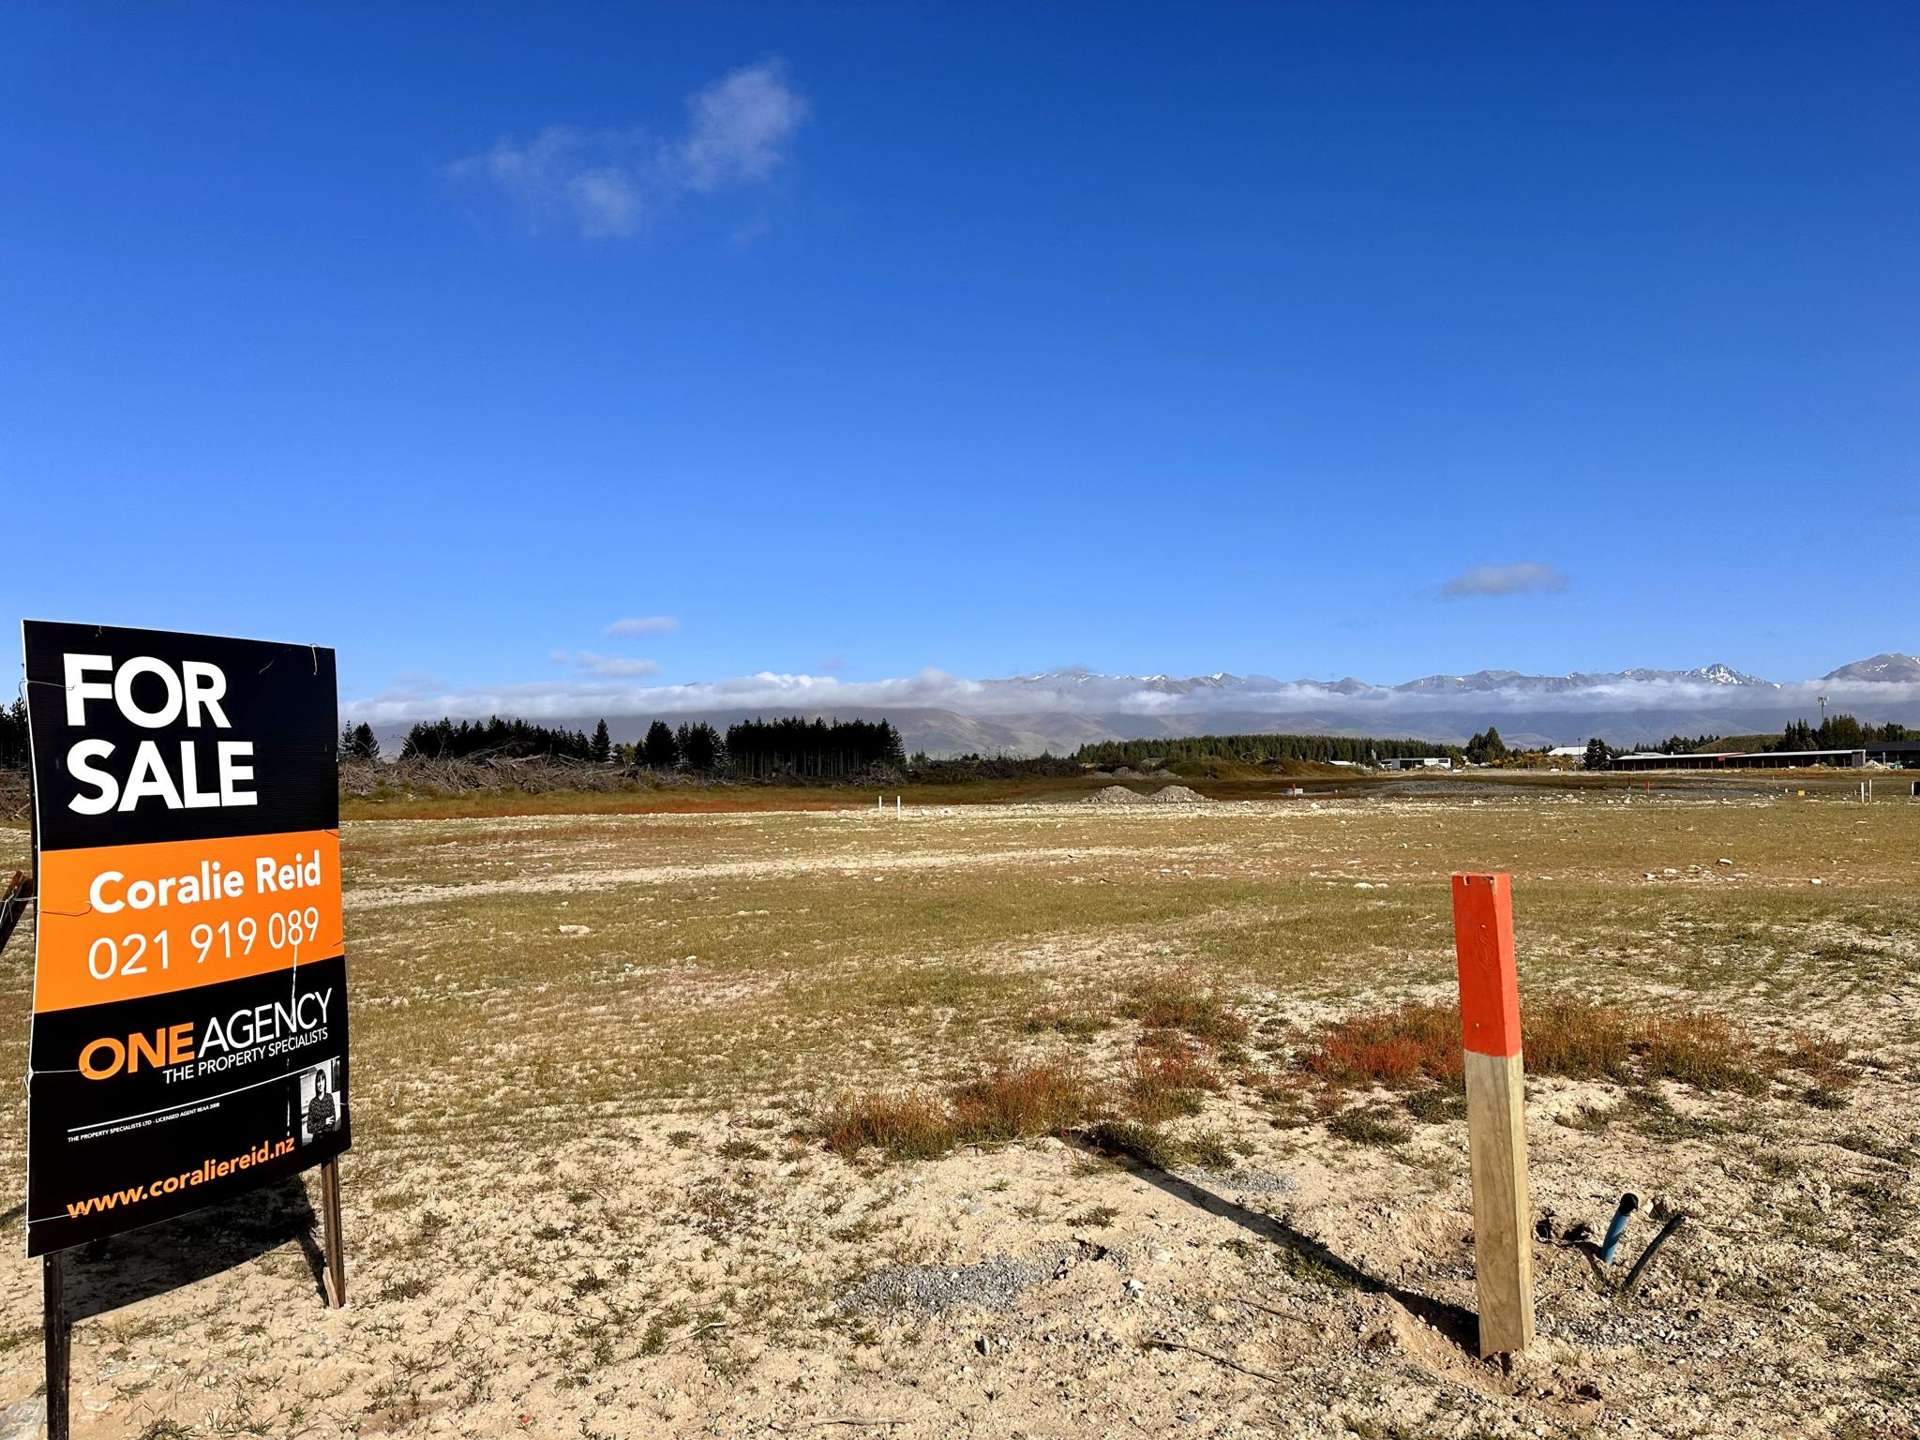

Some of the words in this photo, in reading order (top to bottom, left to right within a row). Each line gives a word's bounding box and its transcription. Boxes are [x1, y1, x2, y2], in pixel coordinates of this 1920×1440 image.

[63, 653, 232, 729] FOR
[66, 739, 258, 816] SALE
[89, 861, 245, 914] Coralie
[255, 850, 321, 893] Reid
[88, 930, 170, 981] 021
[190, 916, 257, 964] 919
[267, 906, 320, 949] 089
[163, 1064, 195, 1085] THE
[198, 1045, 267, 1077] PROPERTY
[268, 1027, 329, 1057] SPECIALISTS
[67, 1135, 80, 1143] THE
[80, 1129, 110, 1140] PROPERTY
[109, 1121, 142, 1135] SPECIALISTS
[142, 1119, 152, 1127] LTD
[155, 1113, 179, 1124] LICENSED
[179, 1108, 197, 1118] AGENT
[66, 1136, 296, 1219] www.coraliereid.nz
